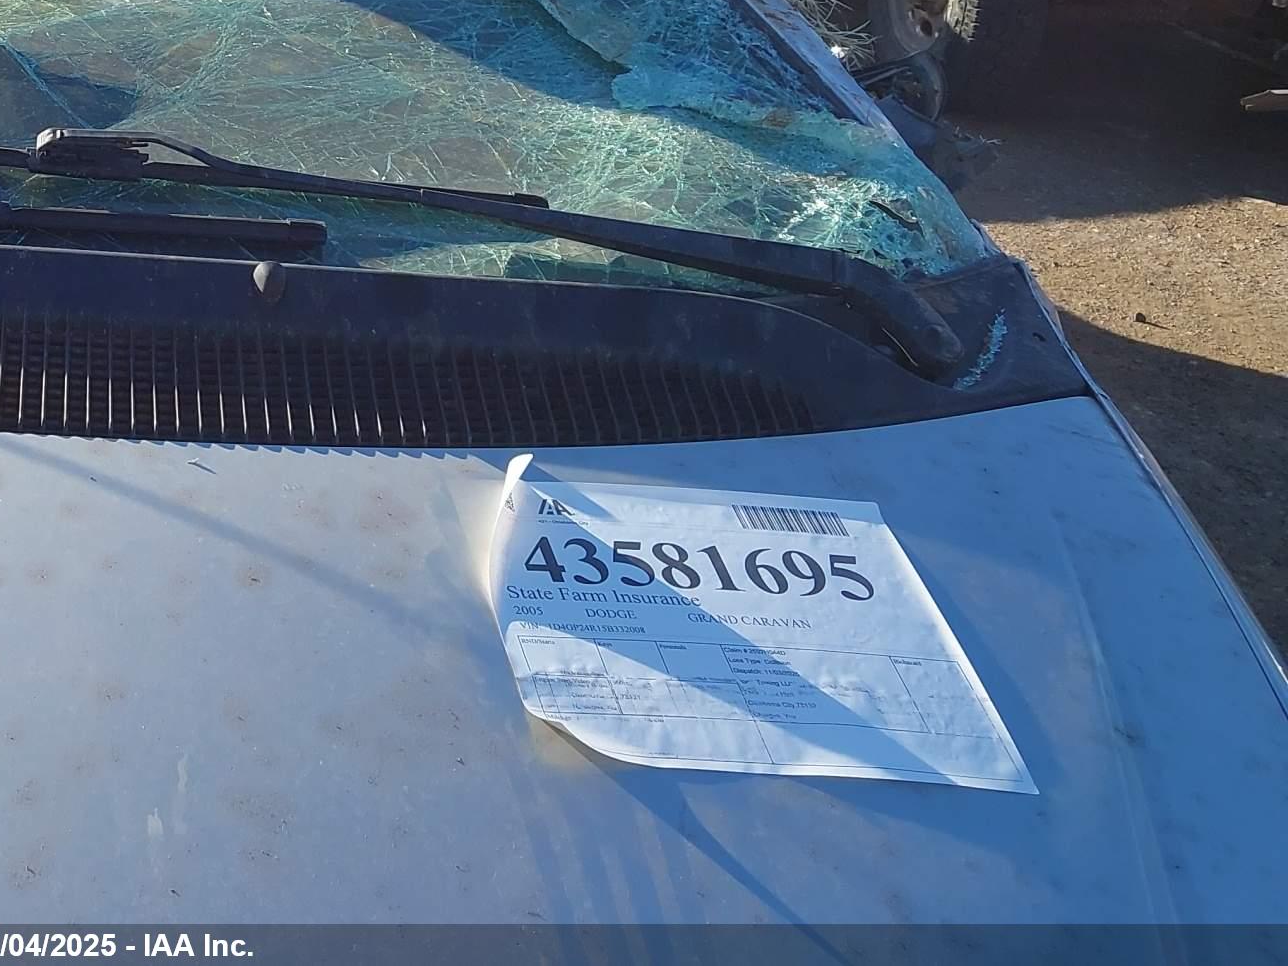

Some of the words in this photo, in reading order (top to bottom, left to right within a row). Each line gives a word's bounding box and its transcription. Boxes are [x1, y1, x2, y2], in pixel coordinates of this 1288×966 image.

[524, 536, 875, 601] 43581695
[507, 586, 554, 600] State
[558, 587, 608, 603] Farm
[613, 589, 702, 607] Insurance
[513, 606, 544, 616] 2005
[585, 608, 638, 620] DODGE
[687, 612, 739, 625] GRAND
[741, 616, 812, 629] CARAVAN
